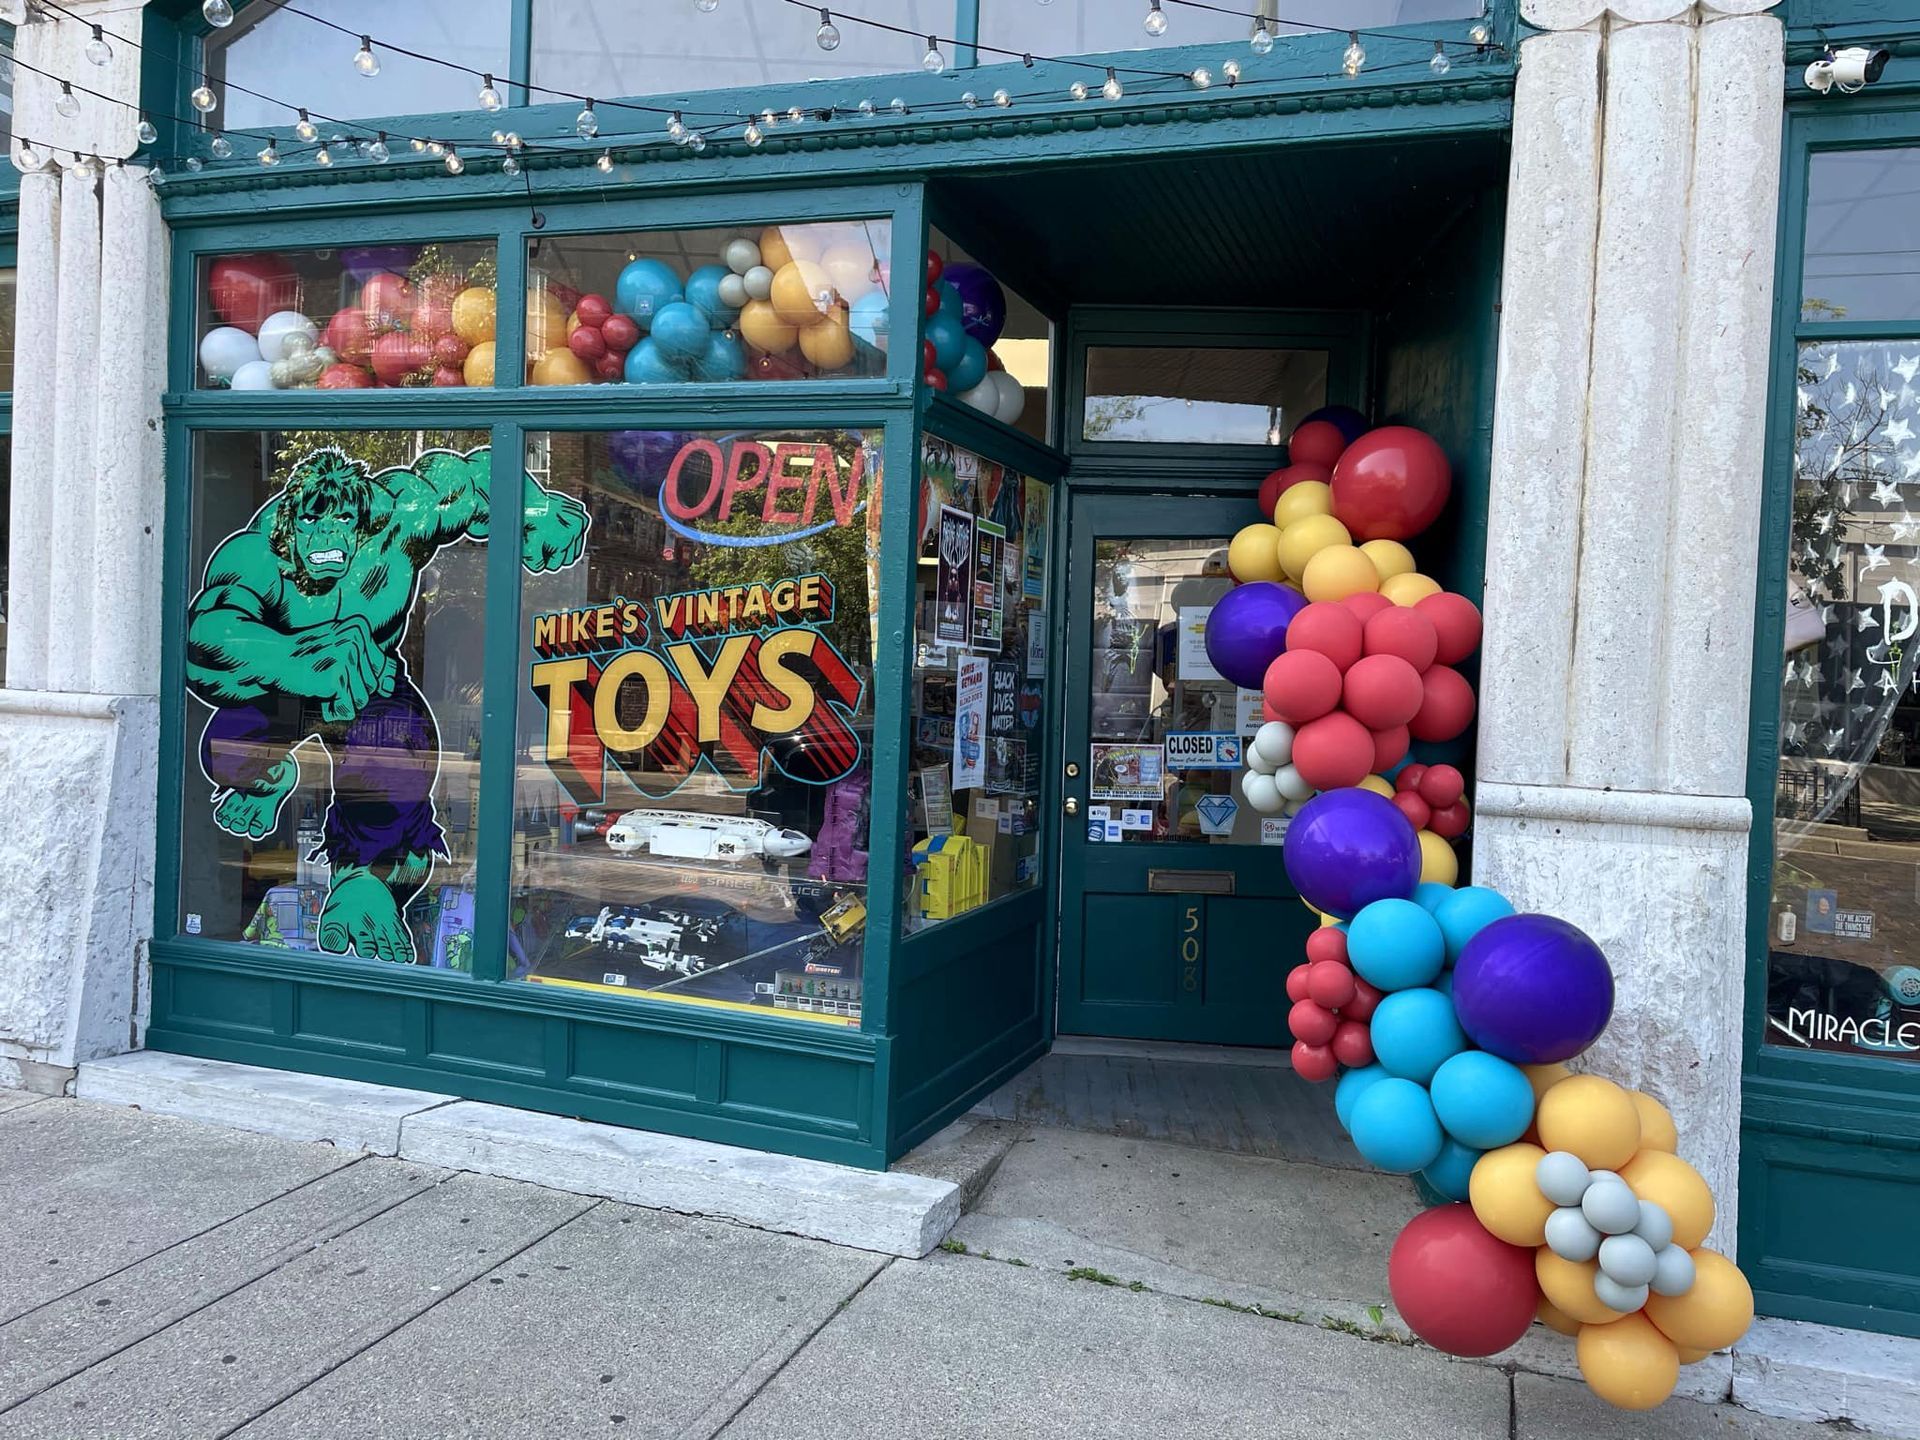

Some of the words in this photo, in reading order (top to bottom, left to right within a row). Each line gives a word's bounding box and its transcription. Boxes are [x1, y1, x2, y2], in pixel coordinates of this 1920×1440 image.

[664, 439, 865, 527] OPEN
[533, 597, 645, 653] MIKE'S
[656, 576, 826, 634] VINTAGE
[961, 663, 975, 677] CHRIS
[994, 671, 1015, 691] BLACK
[531, 629, 850, 780] TOYS
[993, 692, 1014, 712] LIVES
[991, 714, 1014, 732] MATTER
[1169, 736, 1213, 754] CLOSED
[706, 877, 753, 890] SPACE
[769, 883, 821, 897] POLICE
[1788, 1006, 1920, 1049] MIRACLE
